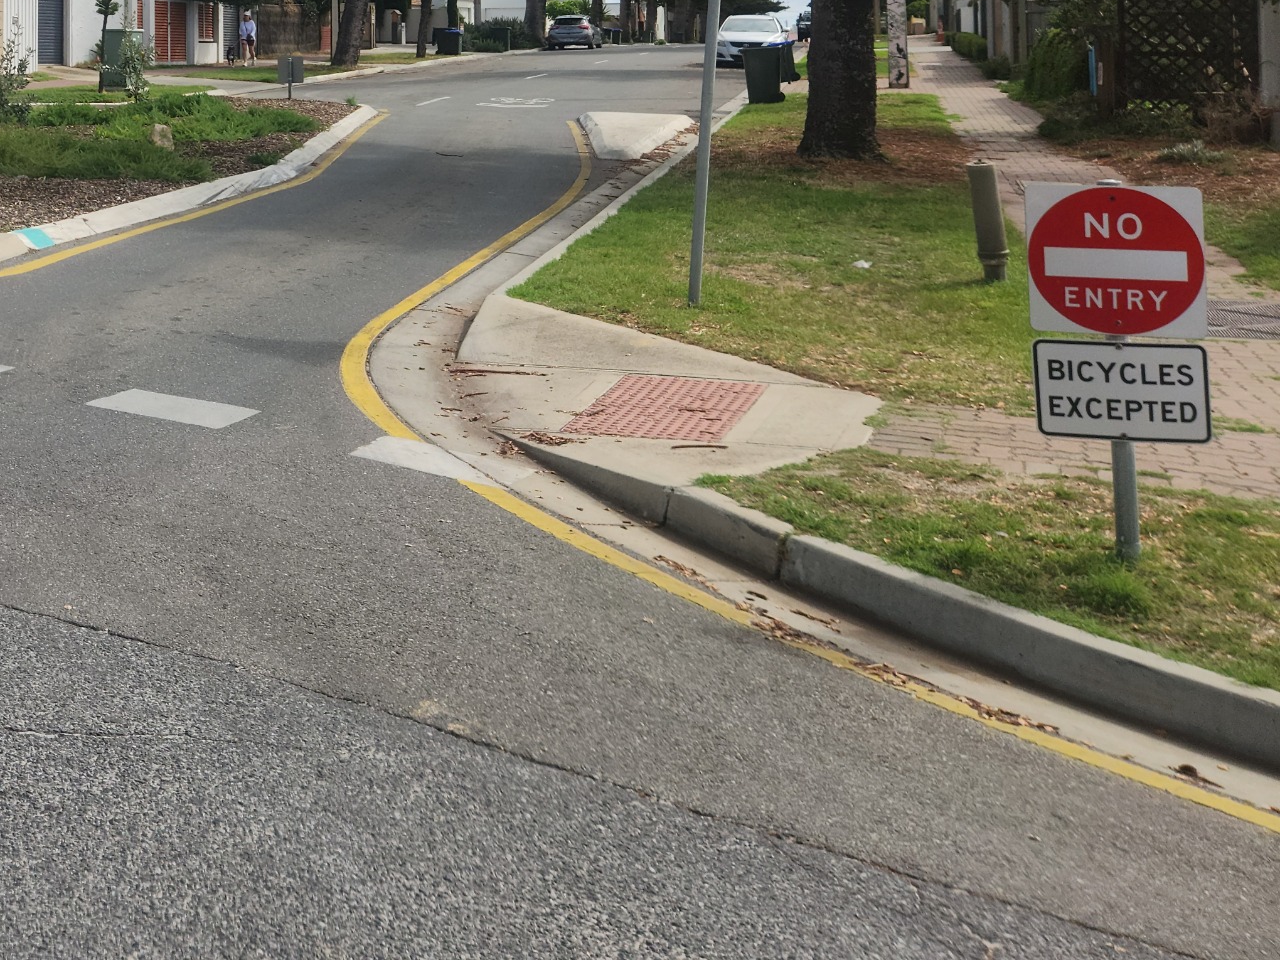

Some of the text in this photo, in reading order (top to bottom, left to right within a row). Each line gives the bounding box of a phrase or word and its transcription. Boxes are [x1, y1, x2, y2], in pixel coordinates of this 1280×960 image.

[1083, 212, 1143, 240] NO
[1064, 286, 1168, 312] ENTRY
[1047, 358, 1194, 387] BICYCLES
[1048, 395, 1198, 424] EXCEPTED
